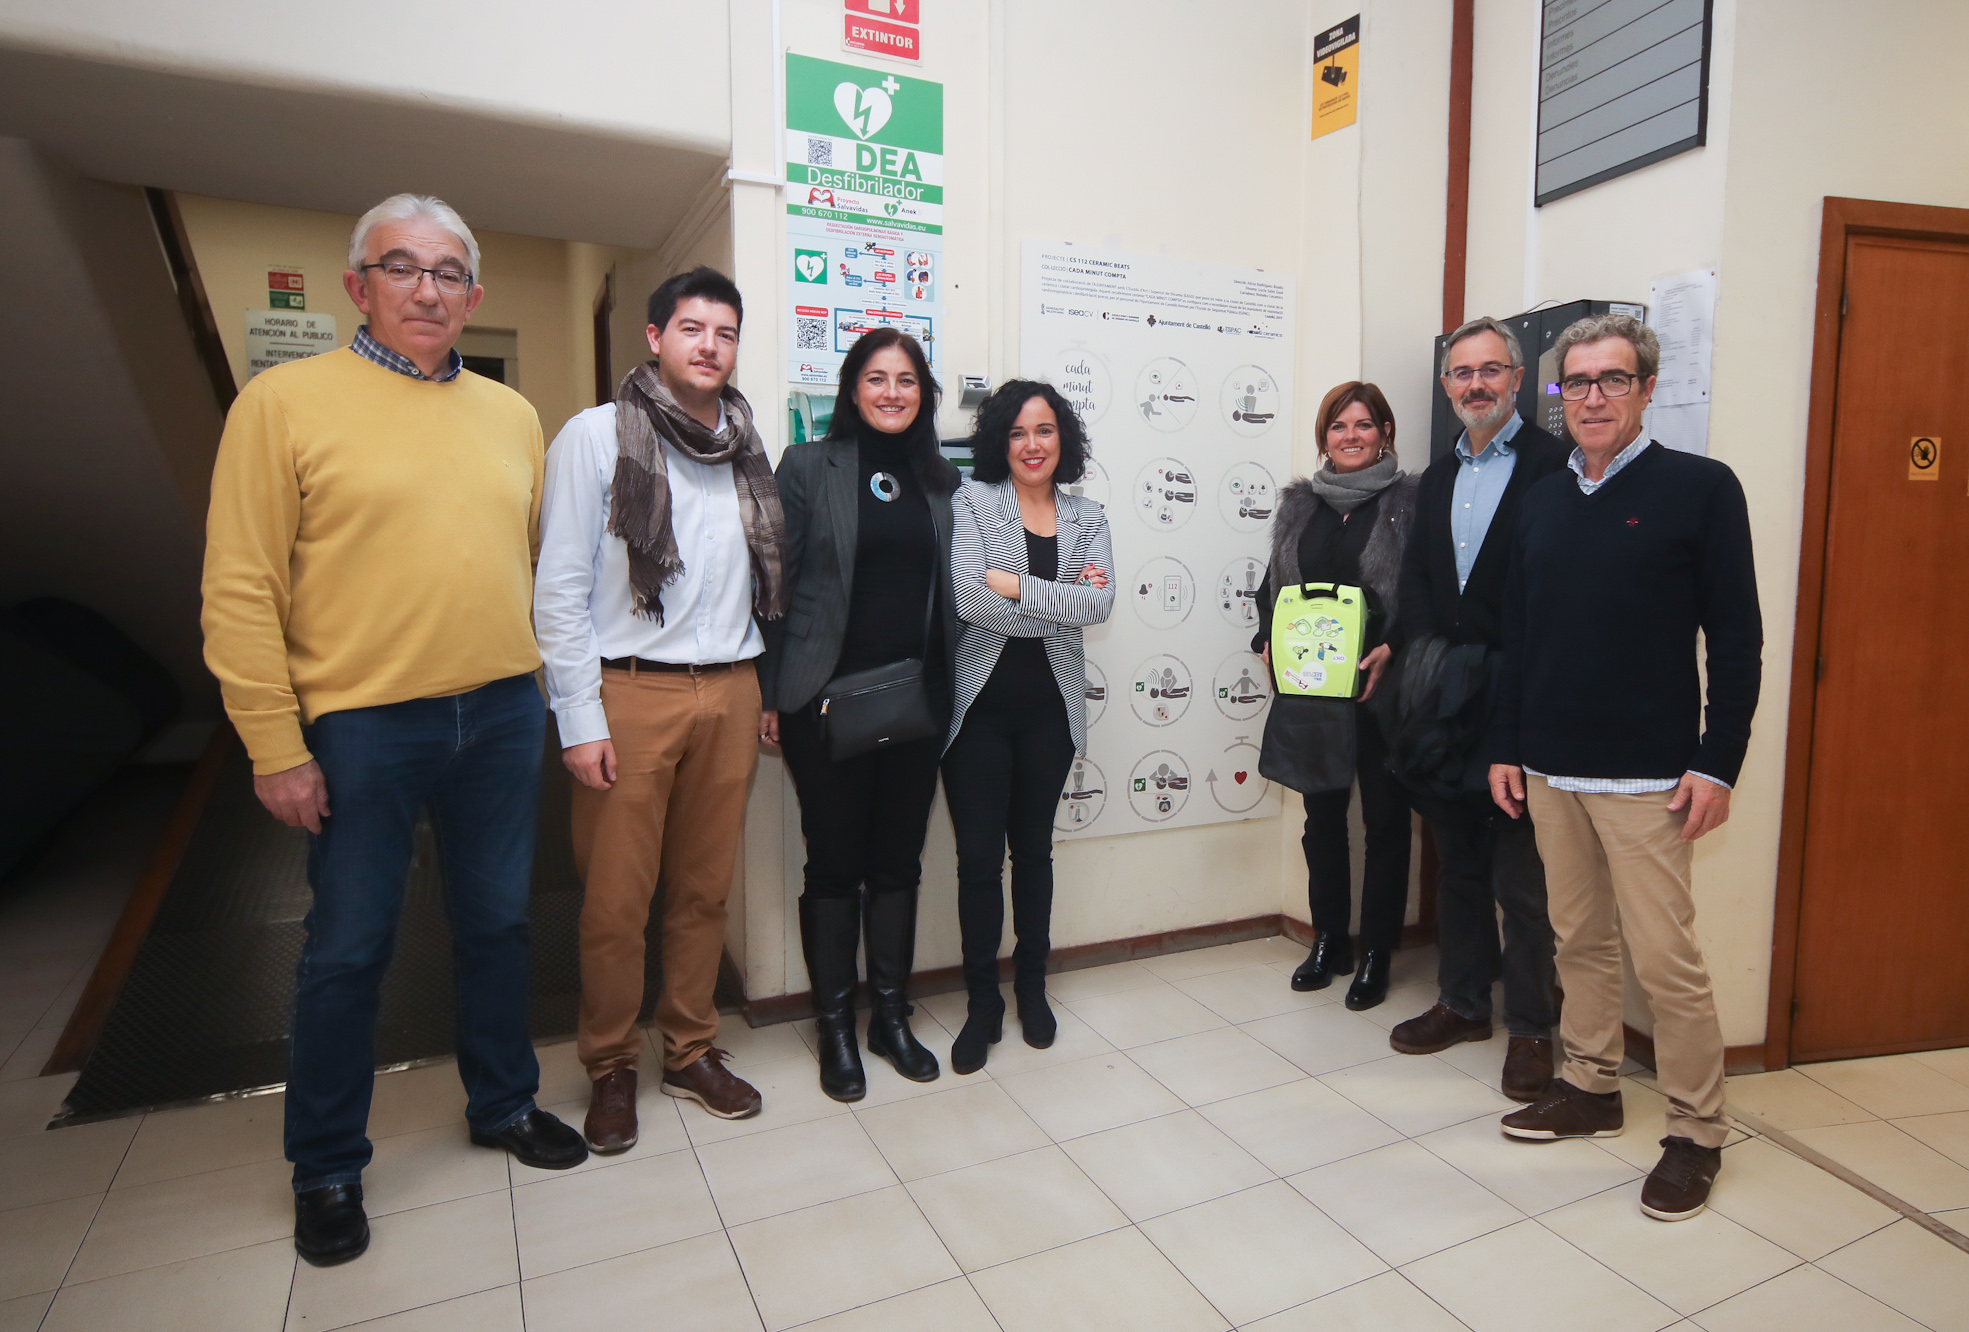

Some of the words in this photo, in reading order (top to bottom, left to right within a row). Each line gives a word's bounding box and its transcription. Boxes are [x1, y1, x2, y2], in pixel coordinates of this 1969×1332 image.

[852, 26, 913, 49] EXTINTOR
[1329, 27, 1344, 41] ZONA
[1317, 32, 1356, 58] VIDEOVIGILADA
[856, 143, 923, 181] DEA
[807, 167, 924, 200] Desfibrilador
[837, 197, 860, 206] Proyecto
[837, 203, 868, 213] Salvavidas
[802, 207, 816, 216] 900
[818, 209, 832, 218] 670
[834, 212, 848, 220] 112
[867, 216, 926, 232] www.salvavidas.eu
[1069, 267, 1083, 275] CADA
[1089, 260, 1113, 268] CERAMIC
[265, 318, 298, 328] HORARIO
[306, 320, 316, 329] DE
[1158, 319, 1185, 328] Ajuntament
[1065, 360, 1092, 376] cada
[1063, 379, 1093, 394] minut
